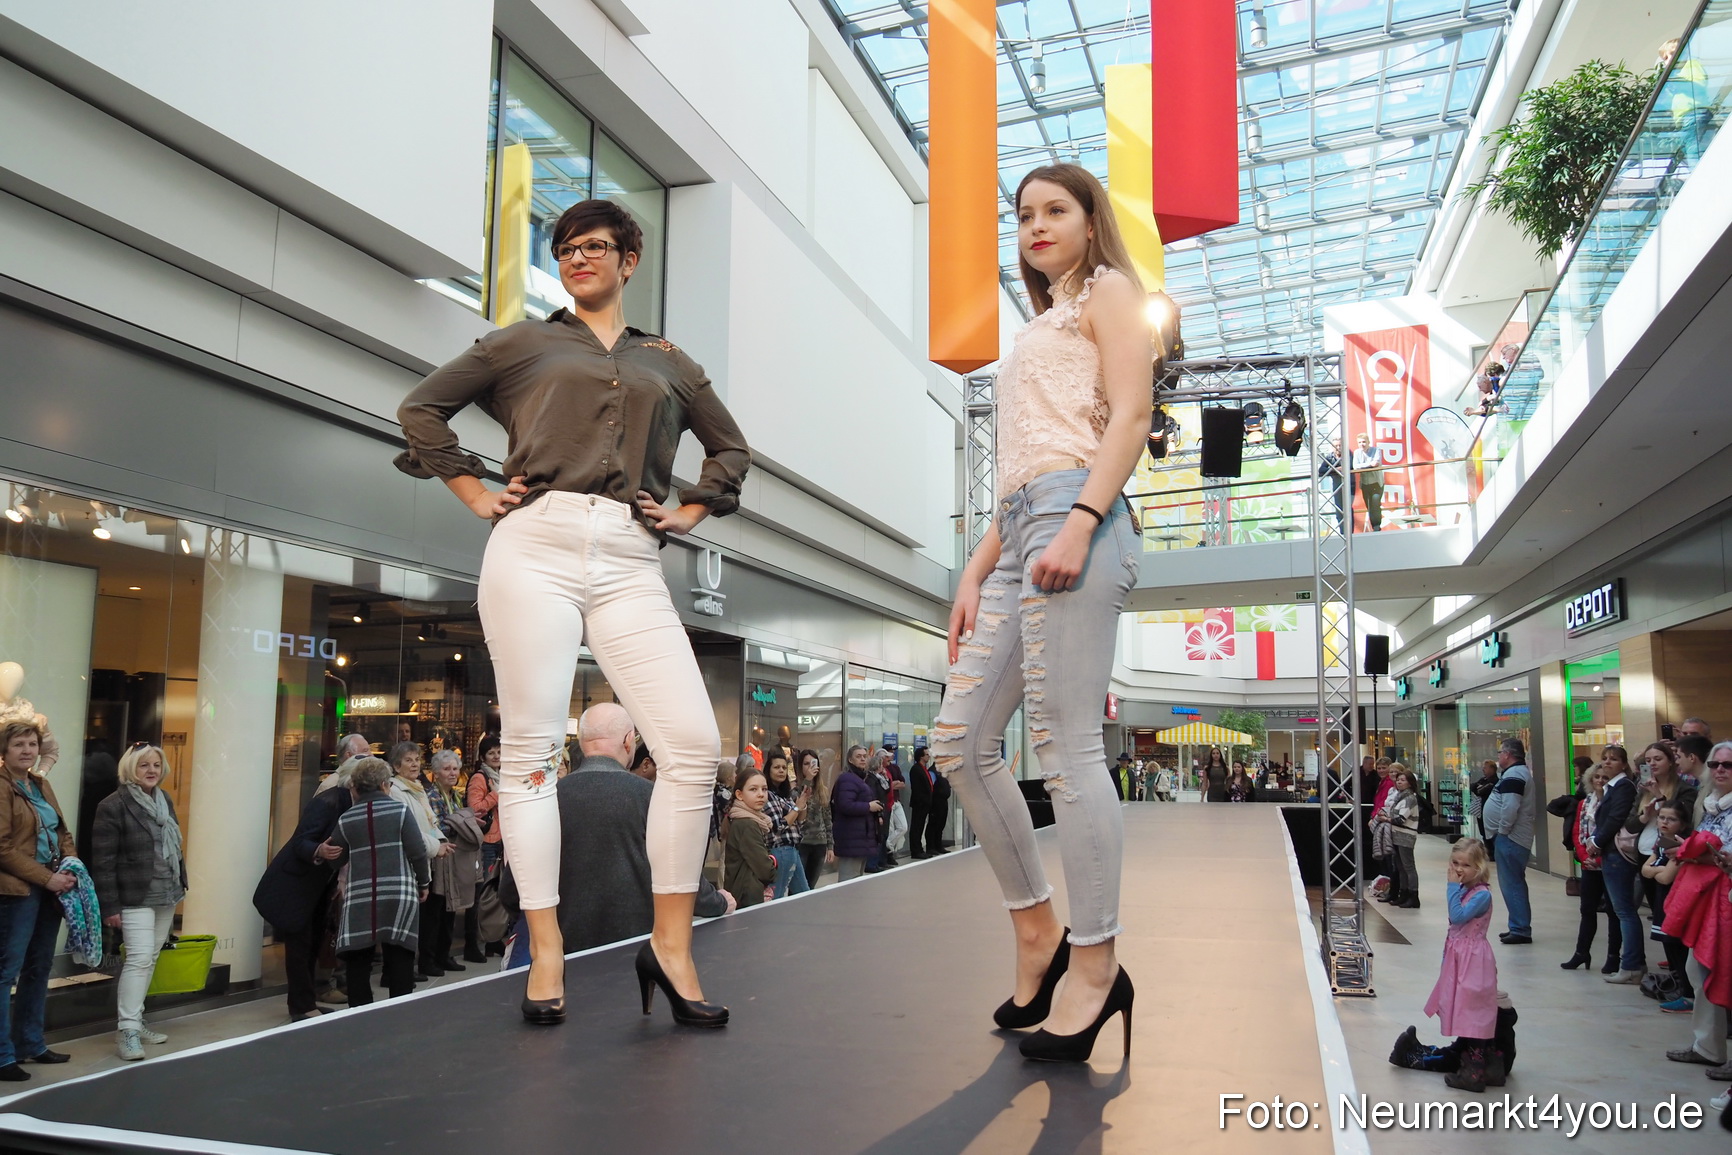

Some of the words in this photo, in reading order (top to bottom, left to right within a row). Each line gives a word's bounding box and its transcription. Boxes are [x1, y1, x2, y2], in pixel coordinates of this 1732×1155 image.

[701, 548, 722, 590] U
[699, 596, 724, 616] eins
[1565, 583, 1612, 630] DEPOT
[351, 697, 378, 708] U-EINS
